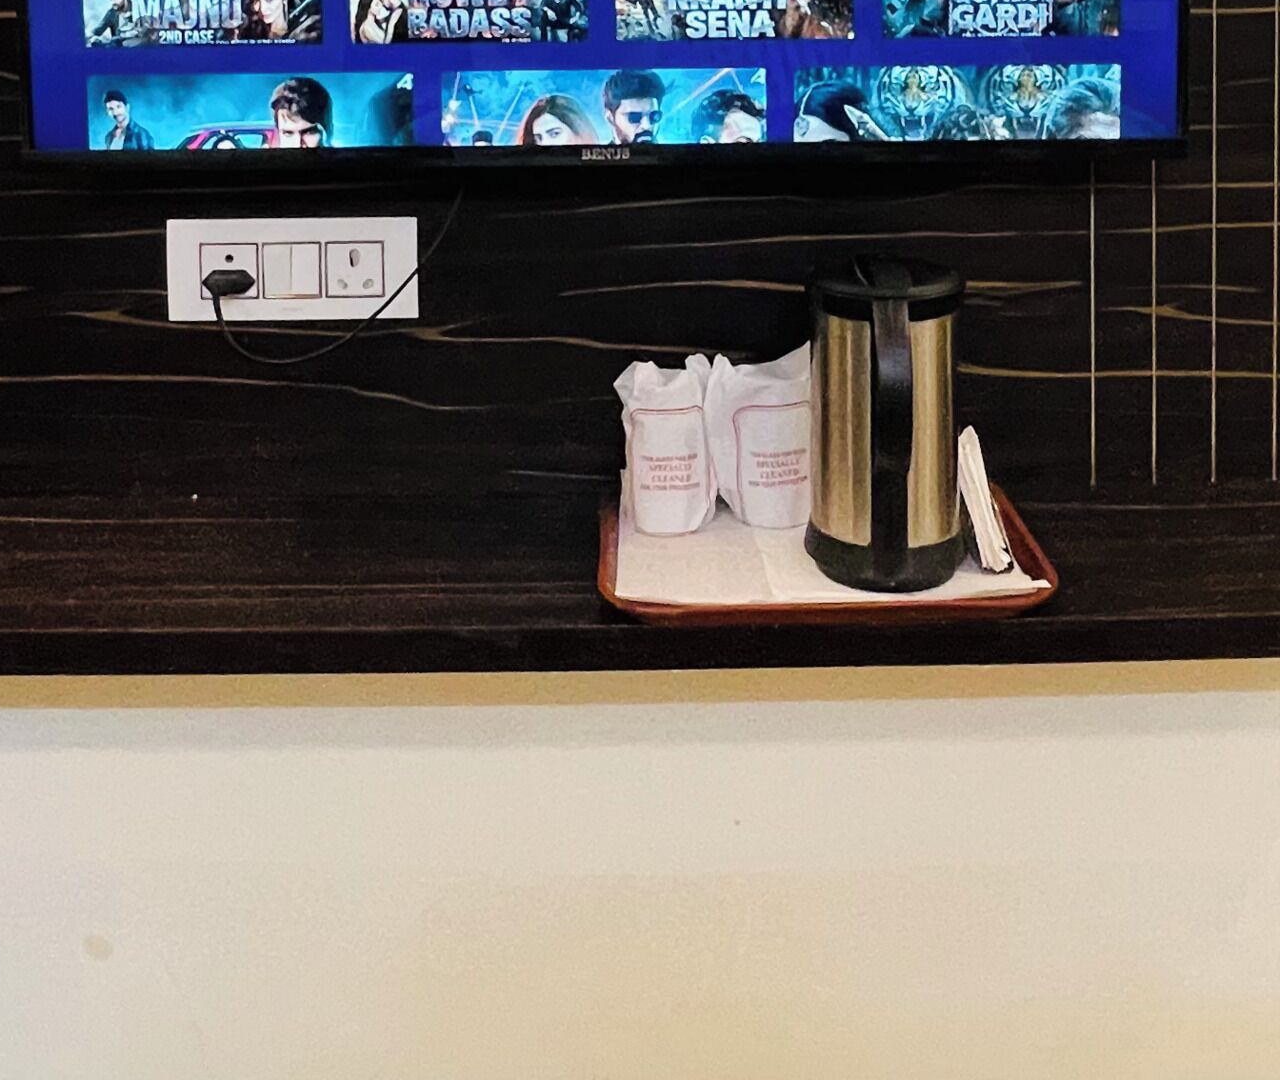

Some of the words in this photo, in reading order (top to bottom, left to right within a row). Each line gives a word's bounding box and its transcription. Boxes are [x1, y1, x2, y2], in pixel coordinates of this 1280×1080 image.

[407, 7, 532, 40] BADASS
[685, 9, 776, 39] SENA
[951, 3, 1052, 34] GARDI
[159, 29, 183, 45] 2ND
[184, 29, 215, 45] CASE
